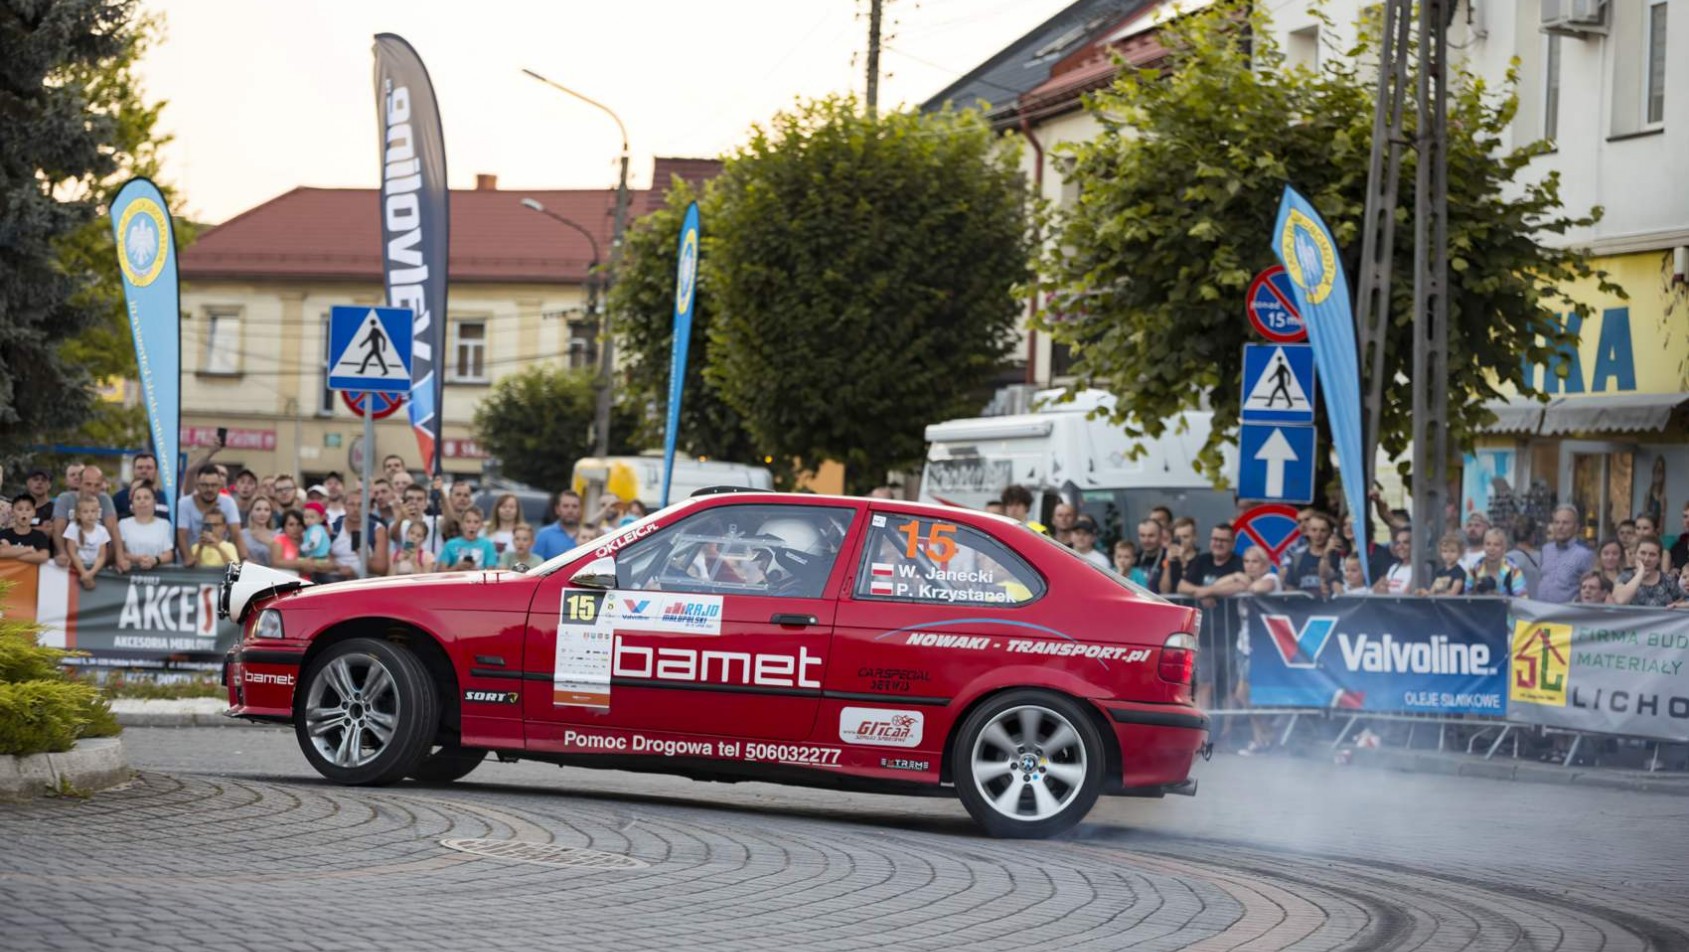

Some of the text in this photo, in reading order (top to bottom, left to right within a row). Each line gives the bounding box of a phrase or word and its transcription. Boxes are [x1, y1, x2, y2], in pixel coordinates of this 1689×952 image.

[898, 520, 958, 562] 15
[898, 564, 993, 583] W. Janecki
[897, 584, 1017, 603] P. Krzystanek
[567, 595, 596, 620] 15
[114, 636, 168, 649] AKCESORIA
[906, 632, 990, 651] NOWAKI
[1006, 639, 1152, 663] TRANSPORT.pl
[613, 635, 823, 688] bamet
[1577, 652, 1683, 676] MATERIAŁY
[245, 670, 295, 686] bamet
[564, 731, 842, 766] Pomoc Drogowa tel 506032277
